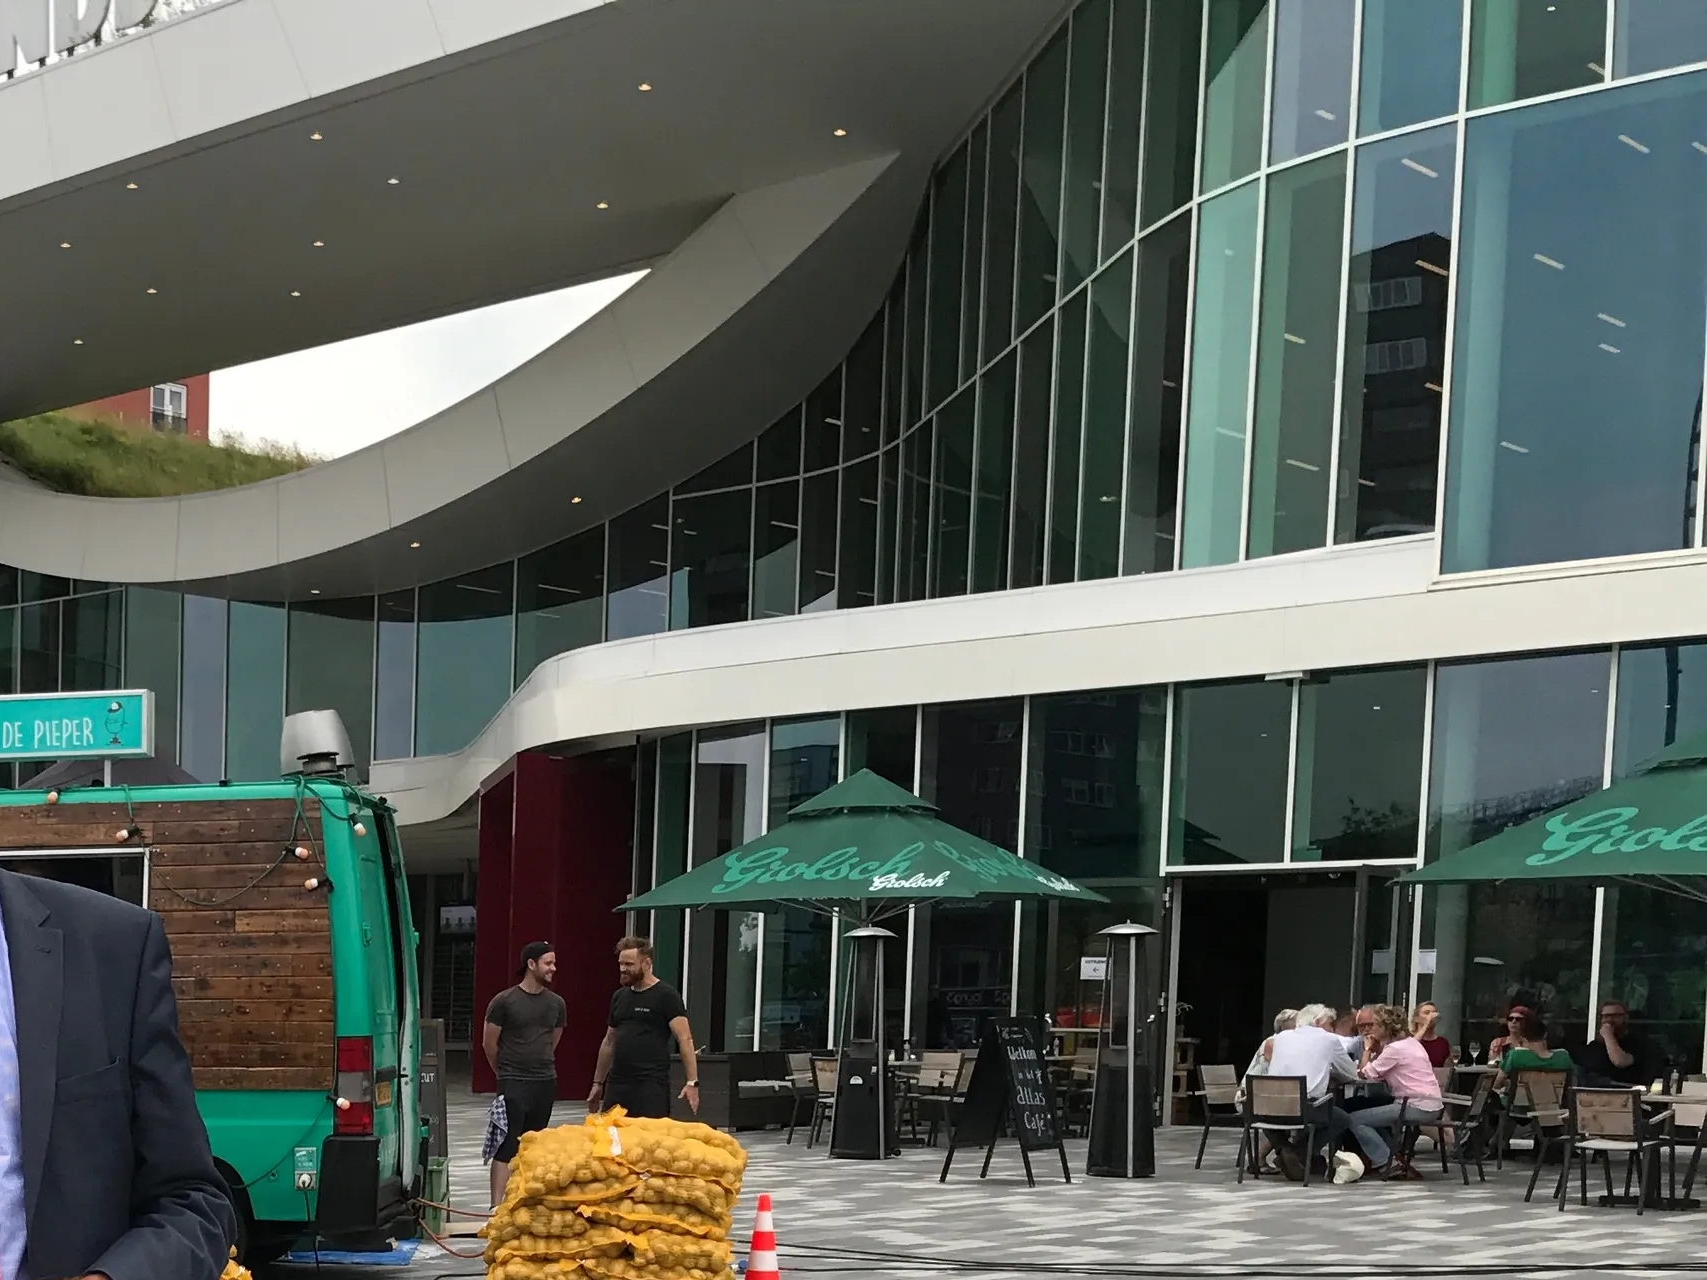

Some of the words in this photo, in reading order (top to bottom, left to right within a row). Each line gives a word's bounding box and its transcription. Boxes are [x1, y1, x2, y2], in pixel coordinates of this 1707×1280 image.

[1, 721, 24, 749] DE
[33, 717, 94, 749] PIEPER
[711, 846, 926, 894] Grolsch
[868, 870, 951, 892] Grolsch
